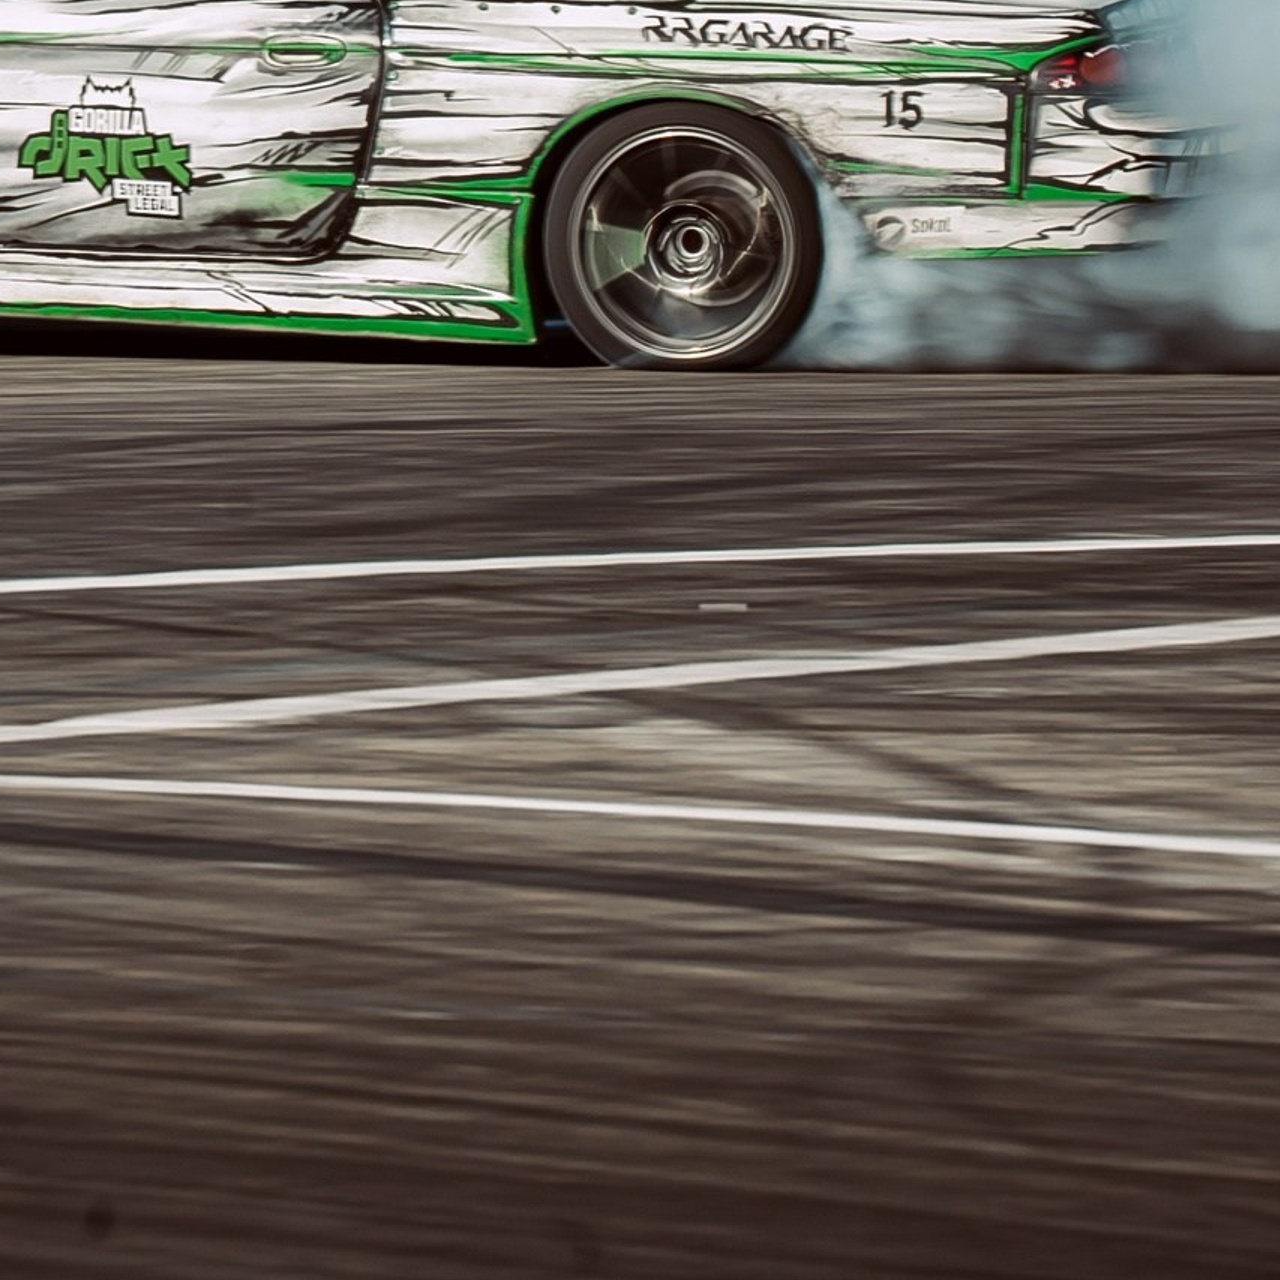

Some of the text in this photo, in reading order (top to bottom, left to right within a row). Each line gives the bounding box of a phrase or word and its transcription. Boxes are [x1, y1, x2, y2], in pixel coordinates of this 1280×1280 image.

[69, 107, 145, 135] GORILLA
[880, 90, 927, 132] 15
[120, 182, 167, 196] STREET
[134, 196, 177, 212] LEGAL
